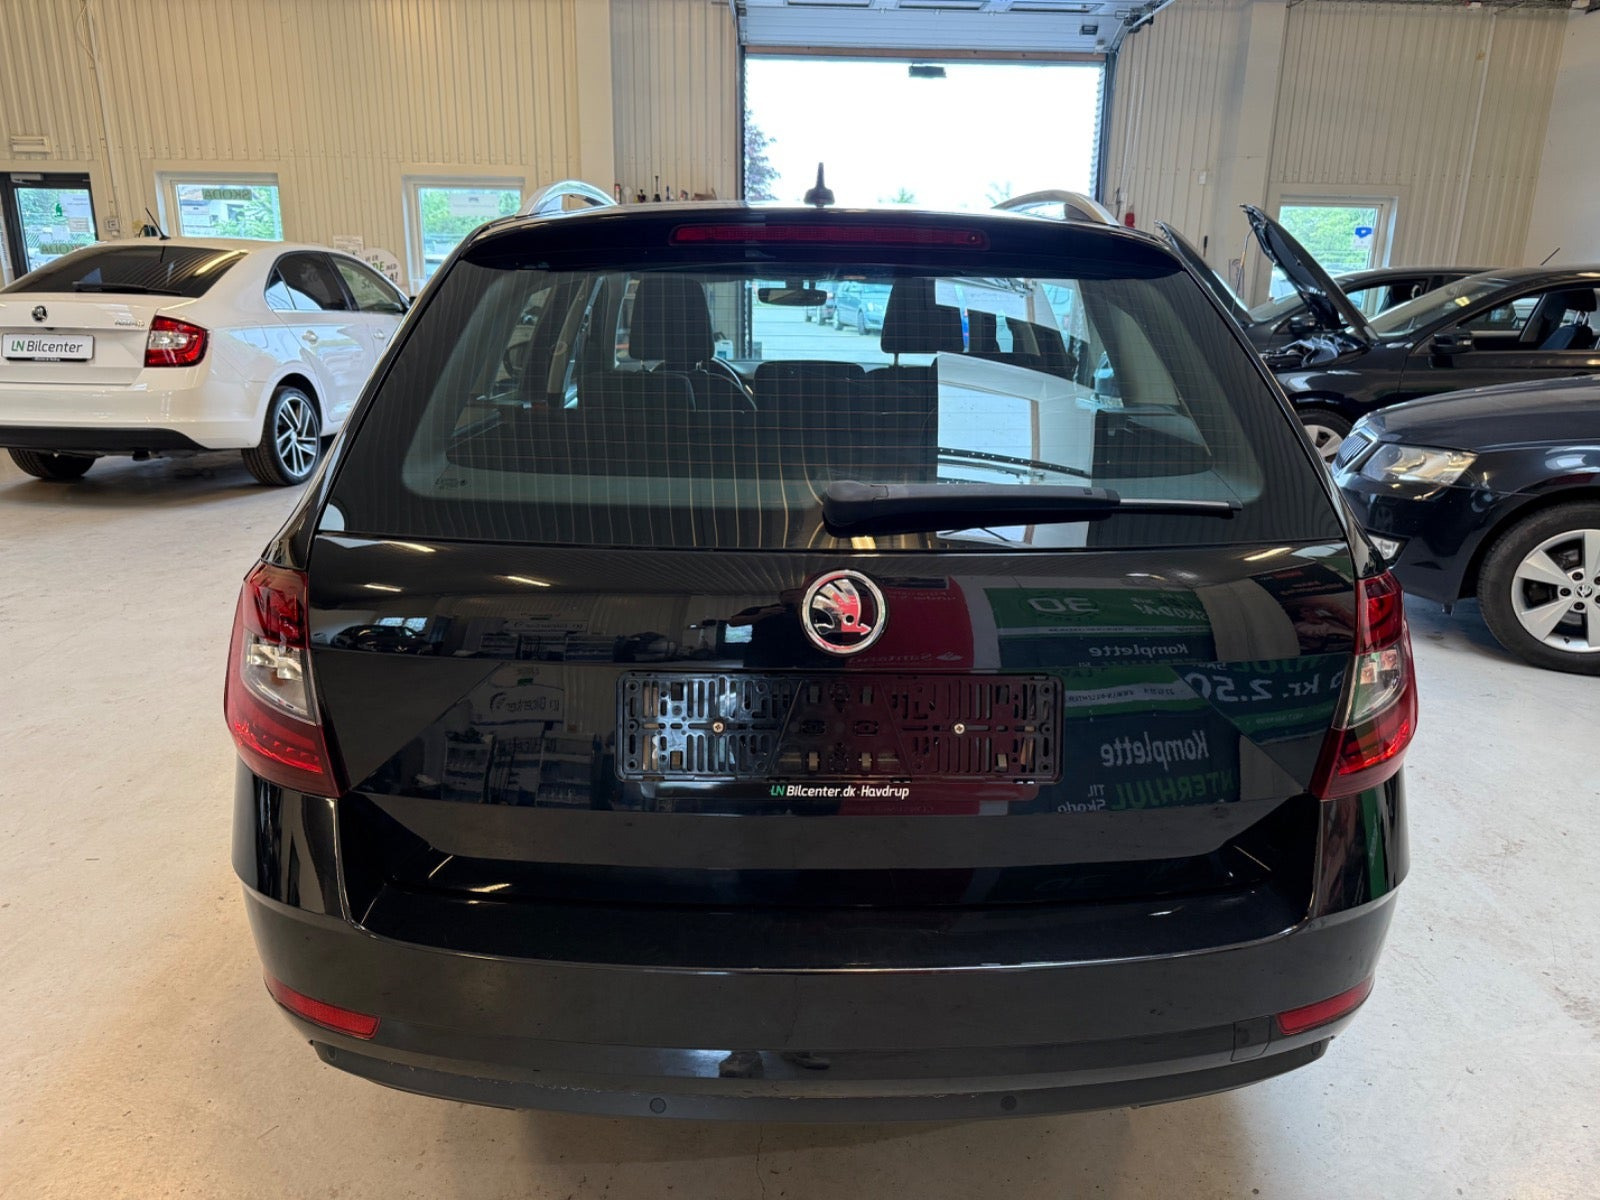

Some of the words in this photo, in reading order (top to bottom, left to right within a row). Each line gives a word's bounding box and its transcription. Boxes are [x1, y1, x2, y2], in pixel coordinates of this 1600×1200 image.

[11, 340, 25, 351] LN
[27, 340, 83, 353] Bilcenter
[770, 785, 785, 796] LN
[861, 785, 910, 800] Havdrup
